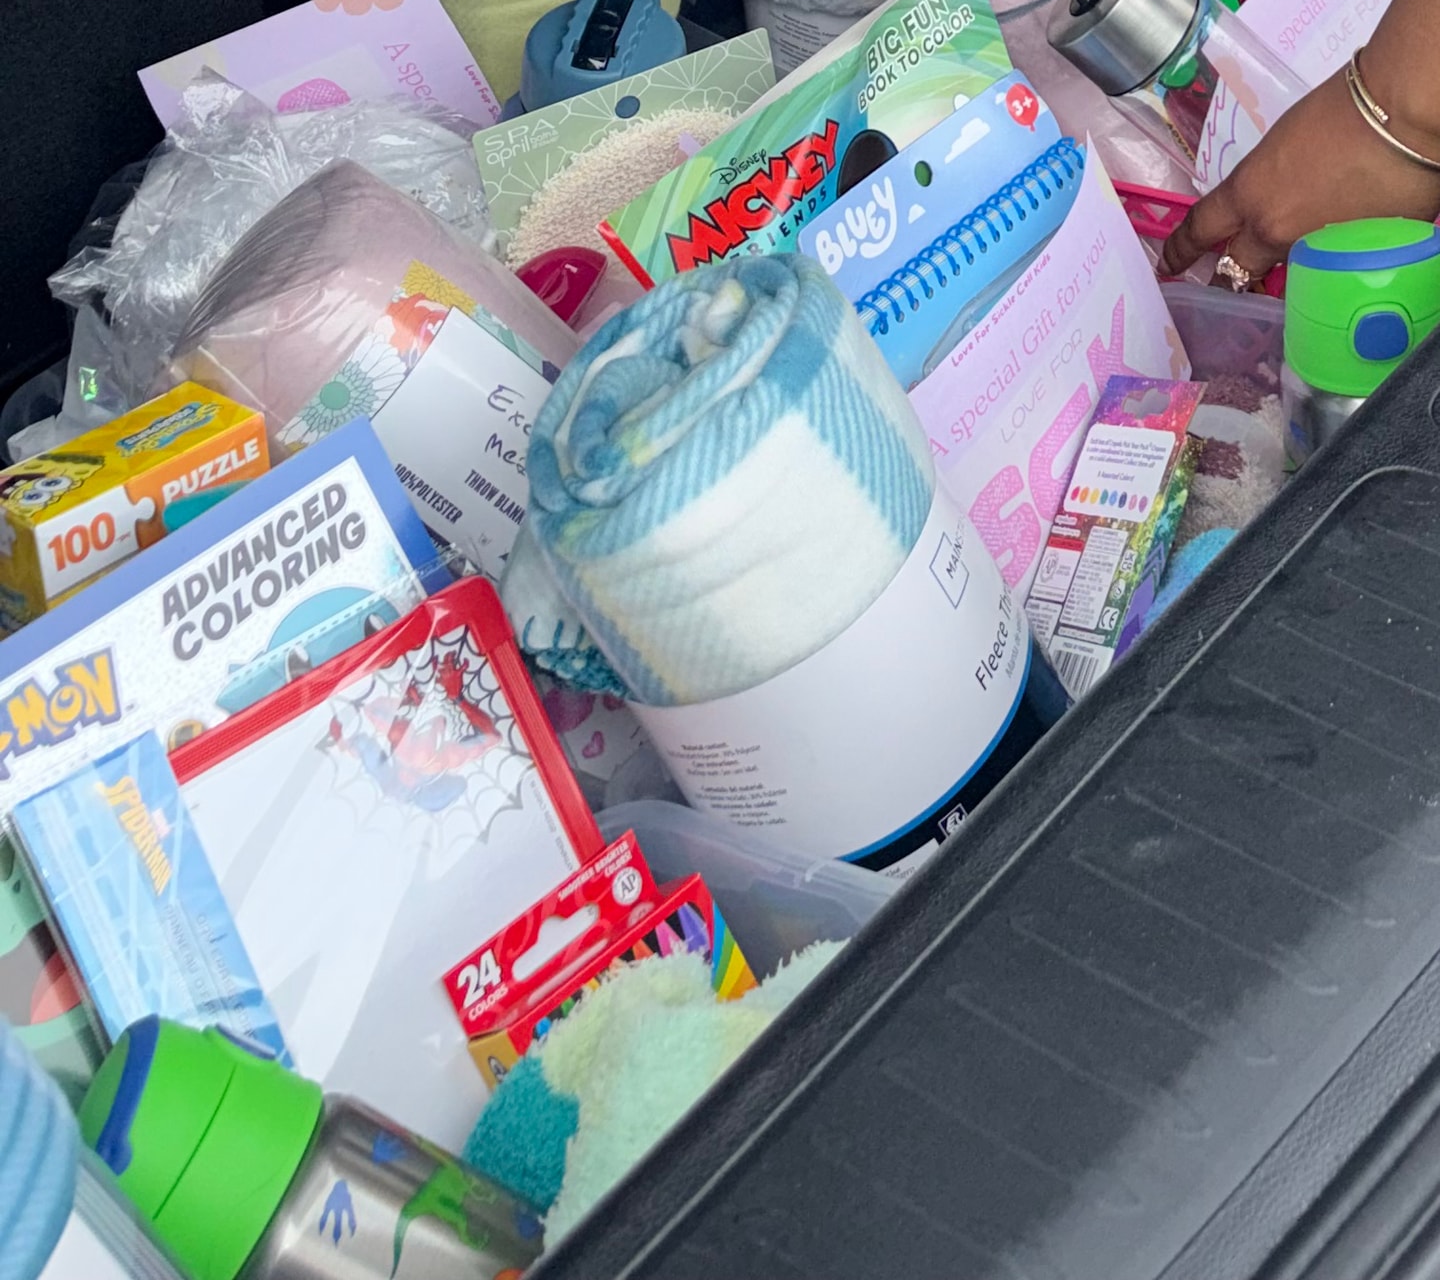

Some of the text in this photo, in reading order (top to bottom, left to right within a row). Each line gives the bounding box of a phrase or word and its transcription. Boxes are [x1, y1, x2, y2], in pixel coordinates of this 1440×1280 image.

[383, 42, 411, 61] A
[857, 4, 975, 113] BOOK TO COLOR
[866, 27, 903, 75] BIG
[1320, 17, 1355, 62] LOVE
[464, 64, 492, 105] Love For
[1011, 95, 1034, 117] 3+
[484, 118, 555, 153] SPA
[486, 137, 530, 168] april
[665, 118, 840, 274] MICKEY
[730, 187, 827, 260] RIENDS
[814, 175, 898, 276] BLUEY
[951, 253, 1052, 368] Love For Sickle Cell Kids
[928, 229, 1107, 459] A special Gift for you
[1000, 328, 1083, 444] LOVE FOR
[162, 438, 261, 506] PUZZLE
[463, 469, 526, 525] THROW BLANK
[47, 512, 116, 572] 100
[162, 482, 347, 628] ADVANCED
[945, 511, 966, 579] MAINST
[172, 512, 366, 661] COLORING
[974, 620, 1009, 691] Fleece
[620, 873, 637, 899] AP
[457, 948, 502, 1009] 24
[468, 983, 509, 1021] COLORS
